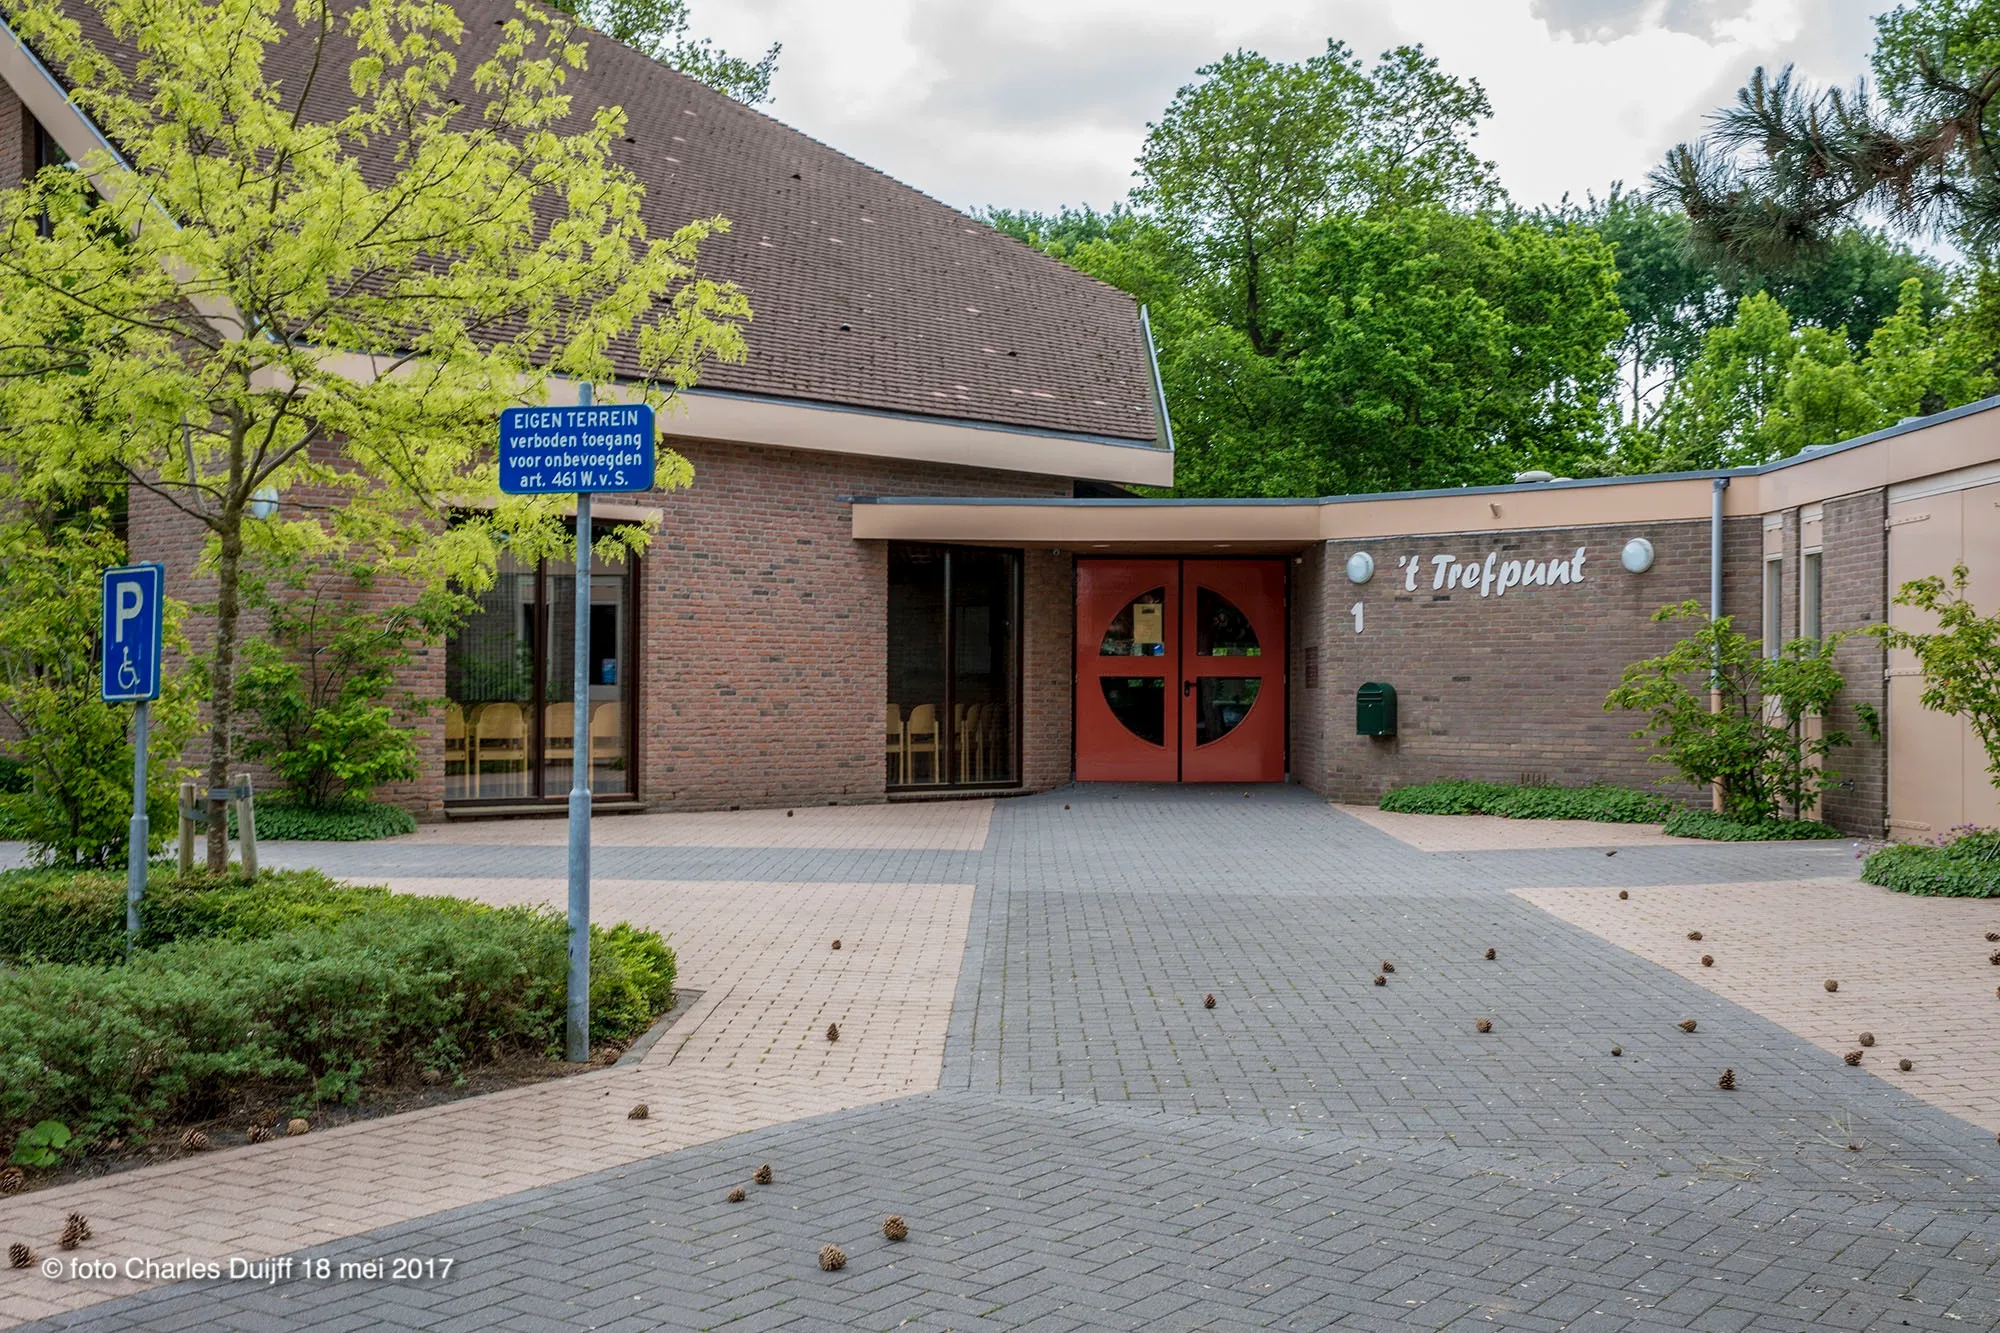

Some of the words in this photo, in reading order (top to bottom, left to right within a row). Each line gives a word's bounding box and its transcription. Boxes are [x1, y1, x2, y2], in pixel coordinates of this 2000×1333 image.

[514, 412, 562, 429] EIGEN
[567, 410, 638, 428] TERREIN
[509, 432, 577, 448] verboden
[581, 432, 642, 451] toegang
[509, 455, 542, 468] voor
[544, 450, 642, 471] onbevoegden
[519, 473, 546, 488] art.
[551, 471, 576, 487] 461
[1431, 546, 1586, 598] Trefpunt
[115, 581, 144, 643] P
[1350, 601, 1364, 634] 1
